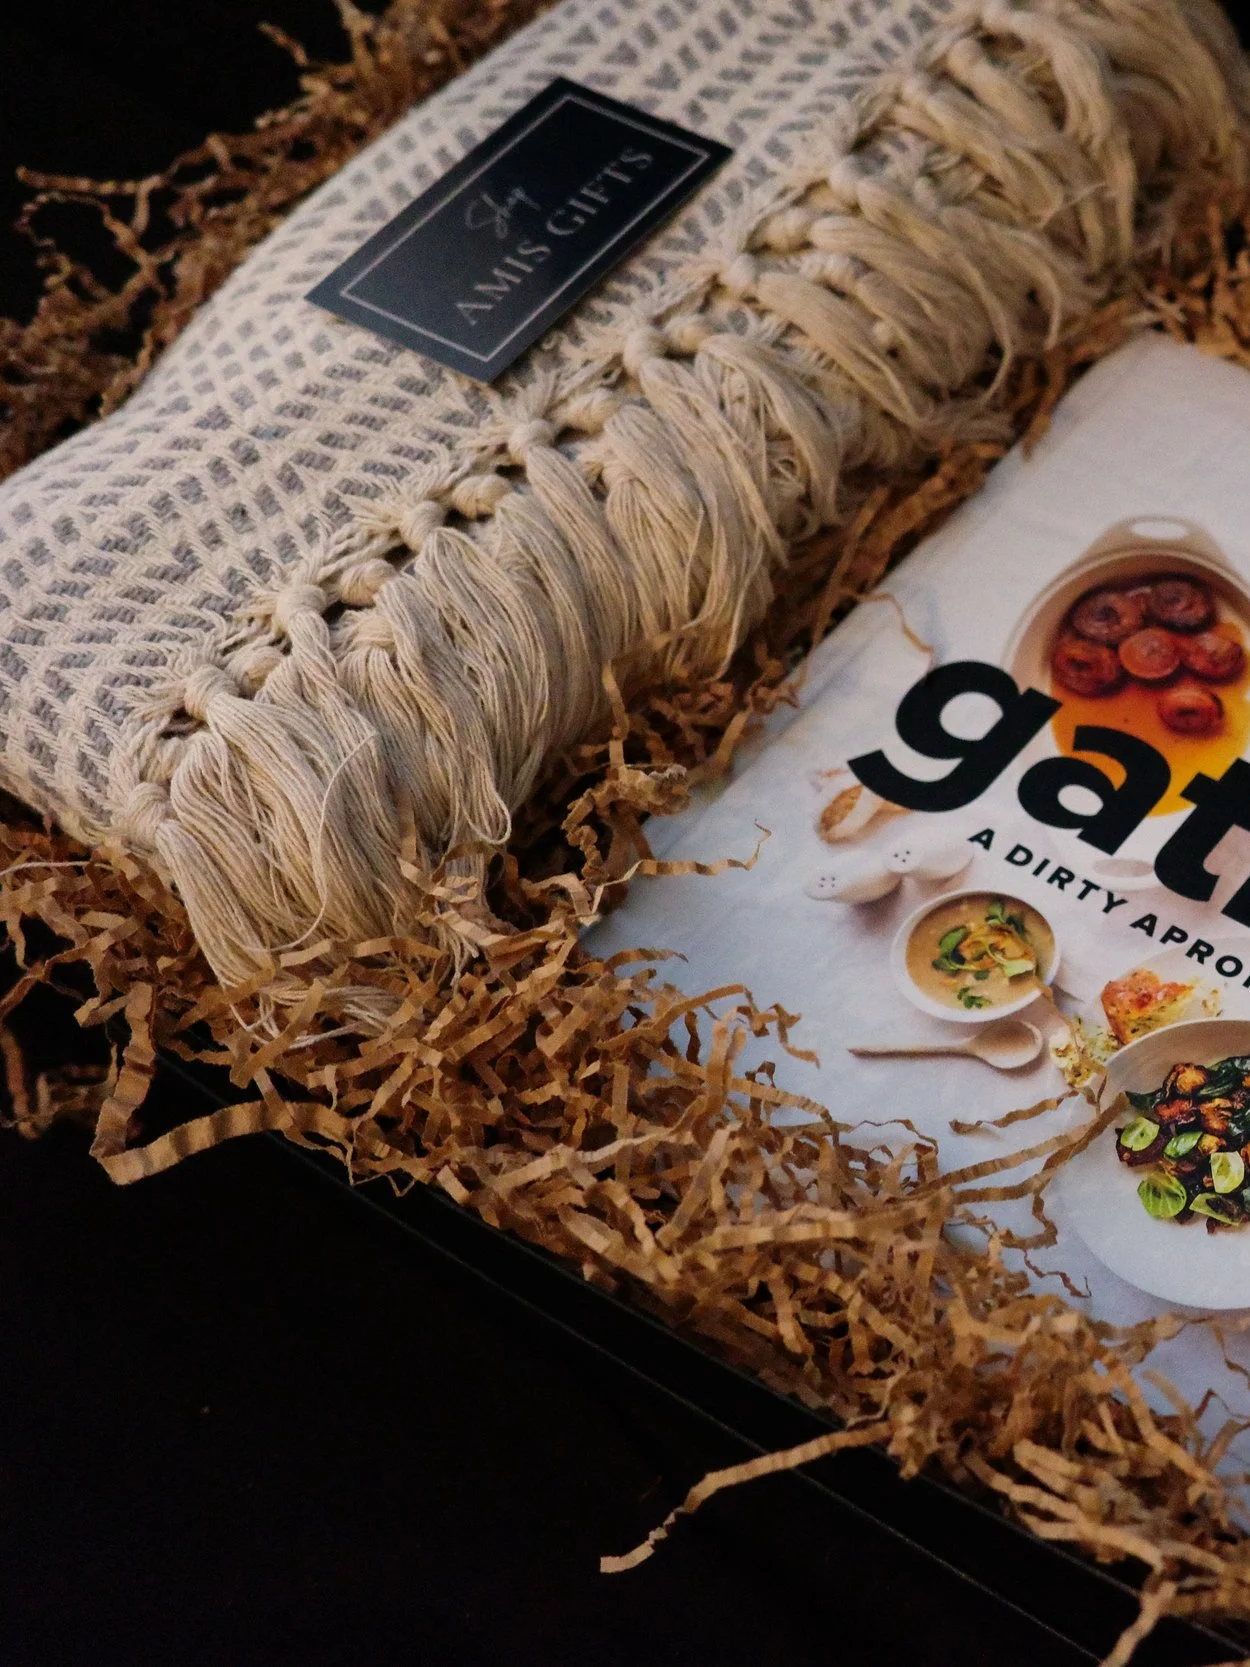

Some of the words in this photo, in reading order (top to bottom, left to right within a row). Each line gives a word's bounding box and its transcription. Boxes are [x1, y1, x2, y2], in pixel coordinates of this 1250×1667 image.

[455, 238, 551, 326] AMIS
[546, 146, 654, 237] GIFTS
[967, 828, 995, 853] A
[1004, 846, 1128, 916] DIRTY
